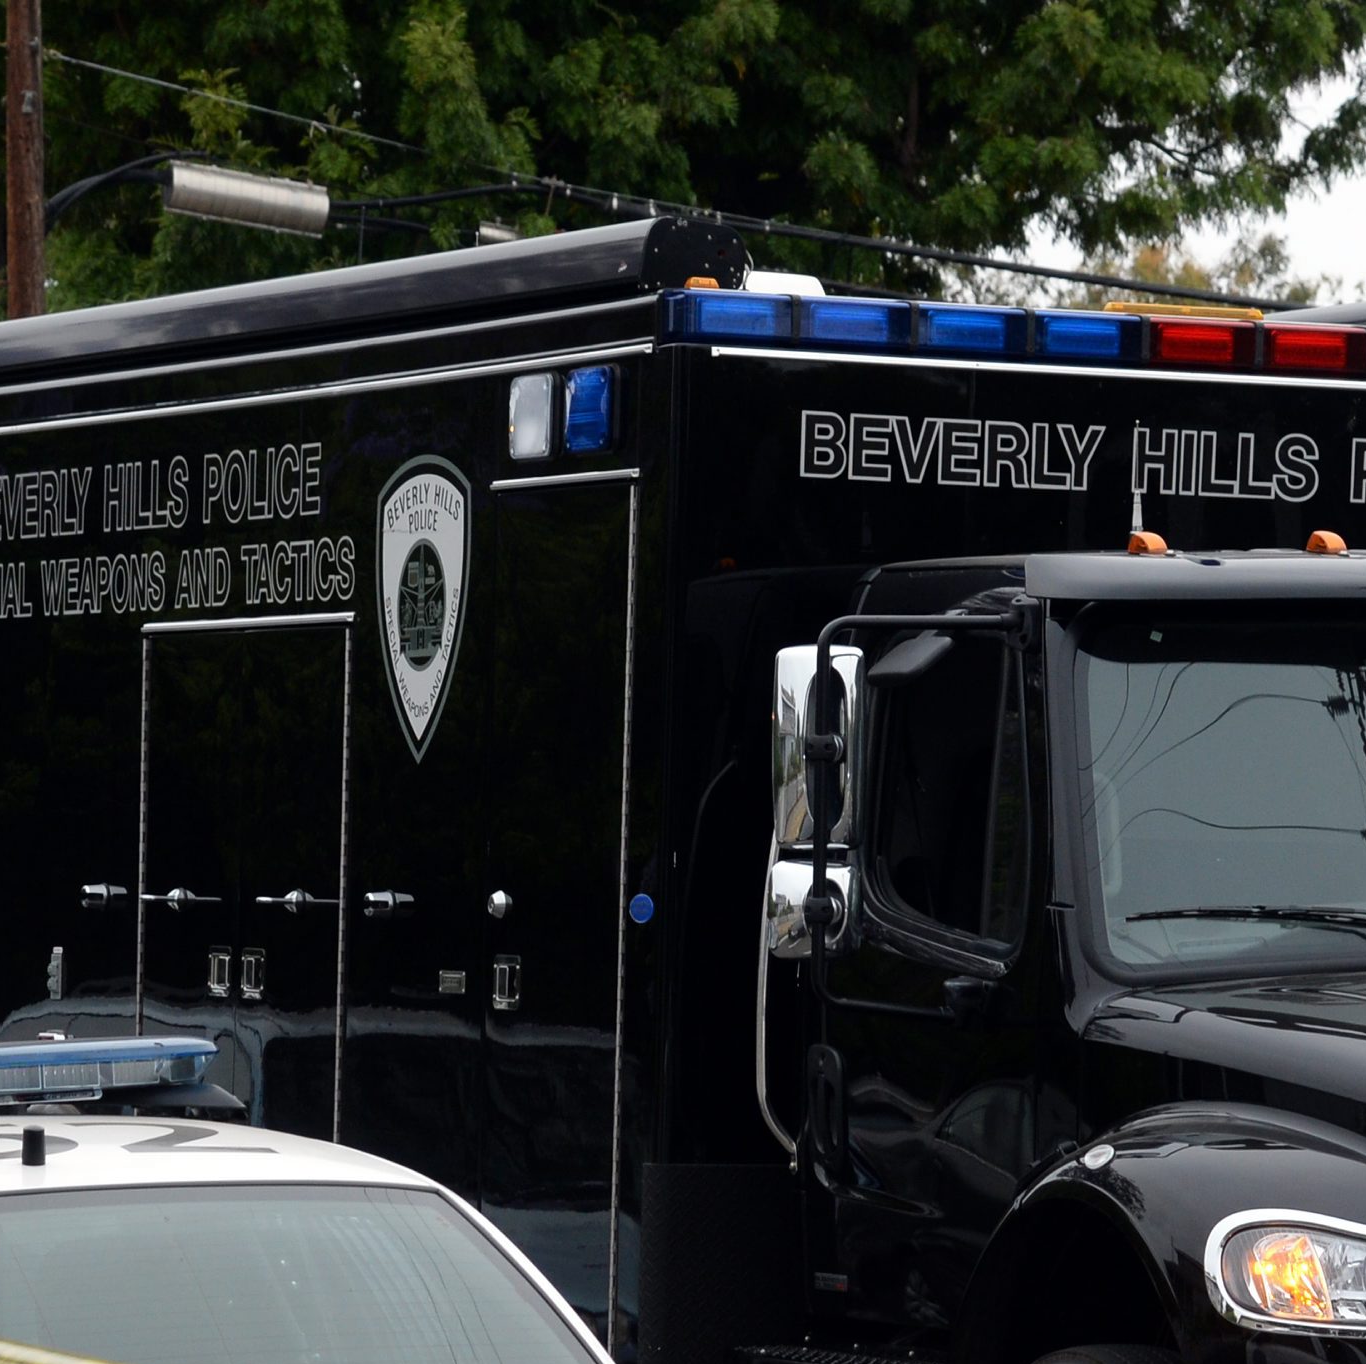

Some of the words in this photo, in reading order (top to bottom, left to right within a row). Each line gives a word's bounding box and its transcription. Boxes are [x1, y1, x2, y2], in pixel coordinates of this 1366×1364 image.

[104, 455, 189, 536] HILLS
[203, 442, 323, 525] POLICE
[799, 410, 1106, 491] BEVERLY
[1131, 426, 1320, 503] HILLS
[387, 483, 431, 530] BEVERLY
[434, 485, 461, 521] HILLS
[408, 510, 438, 534] POLICE
[41, 549, 166, 617] WEAPONS
[175, 547, 230, 609] AND
[241, 535, 356, 603] TACTICS
[385, 596, 400, 664] SPECIAL
[398, 674, 430, 718] WEAPONS
[430, 669, 443, 707] AND
[442, 587, 460, 662] TACTICS
